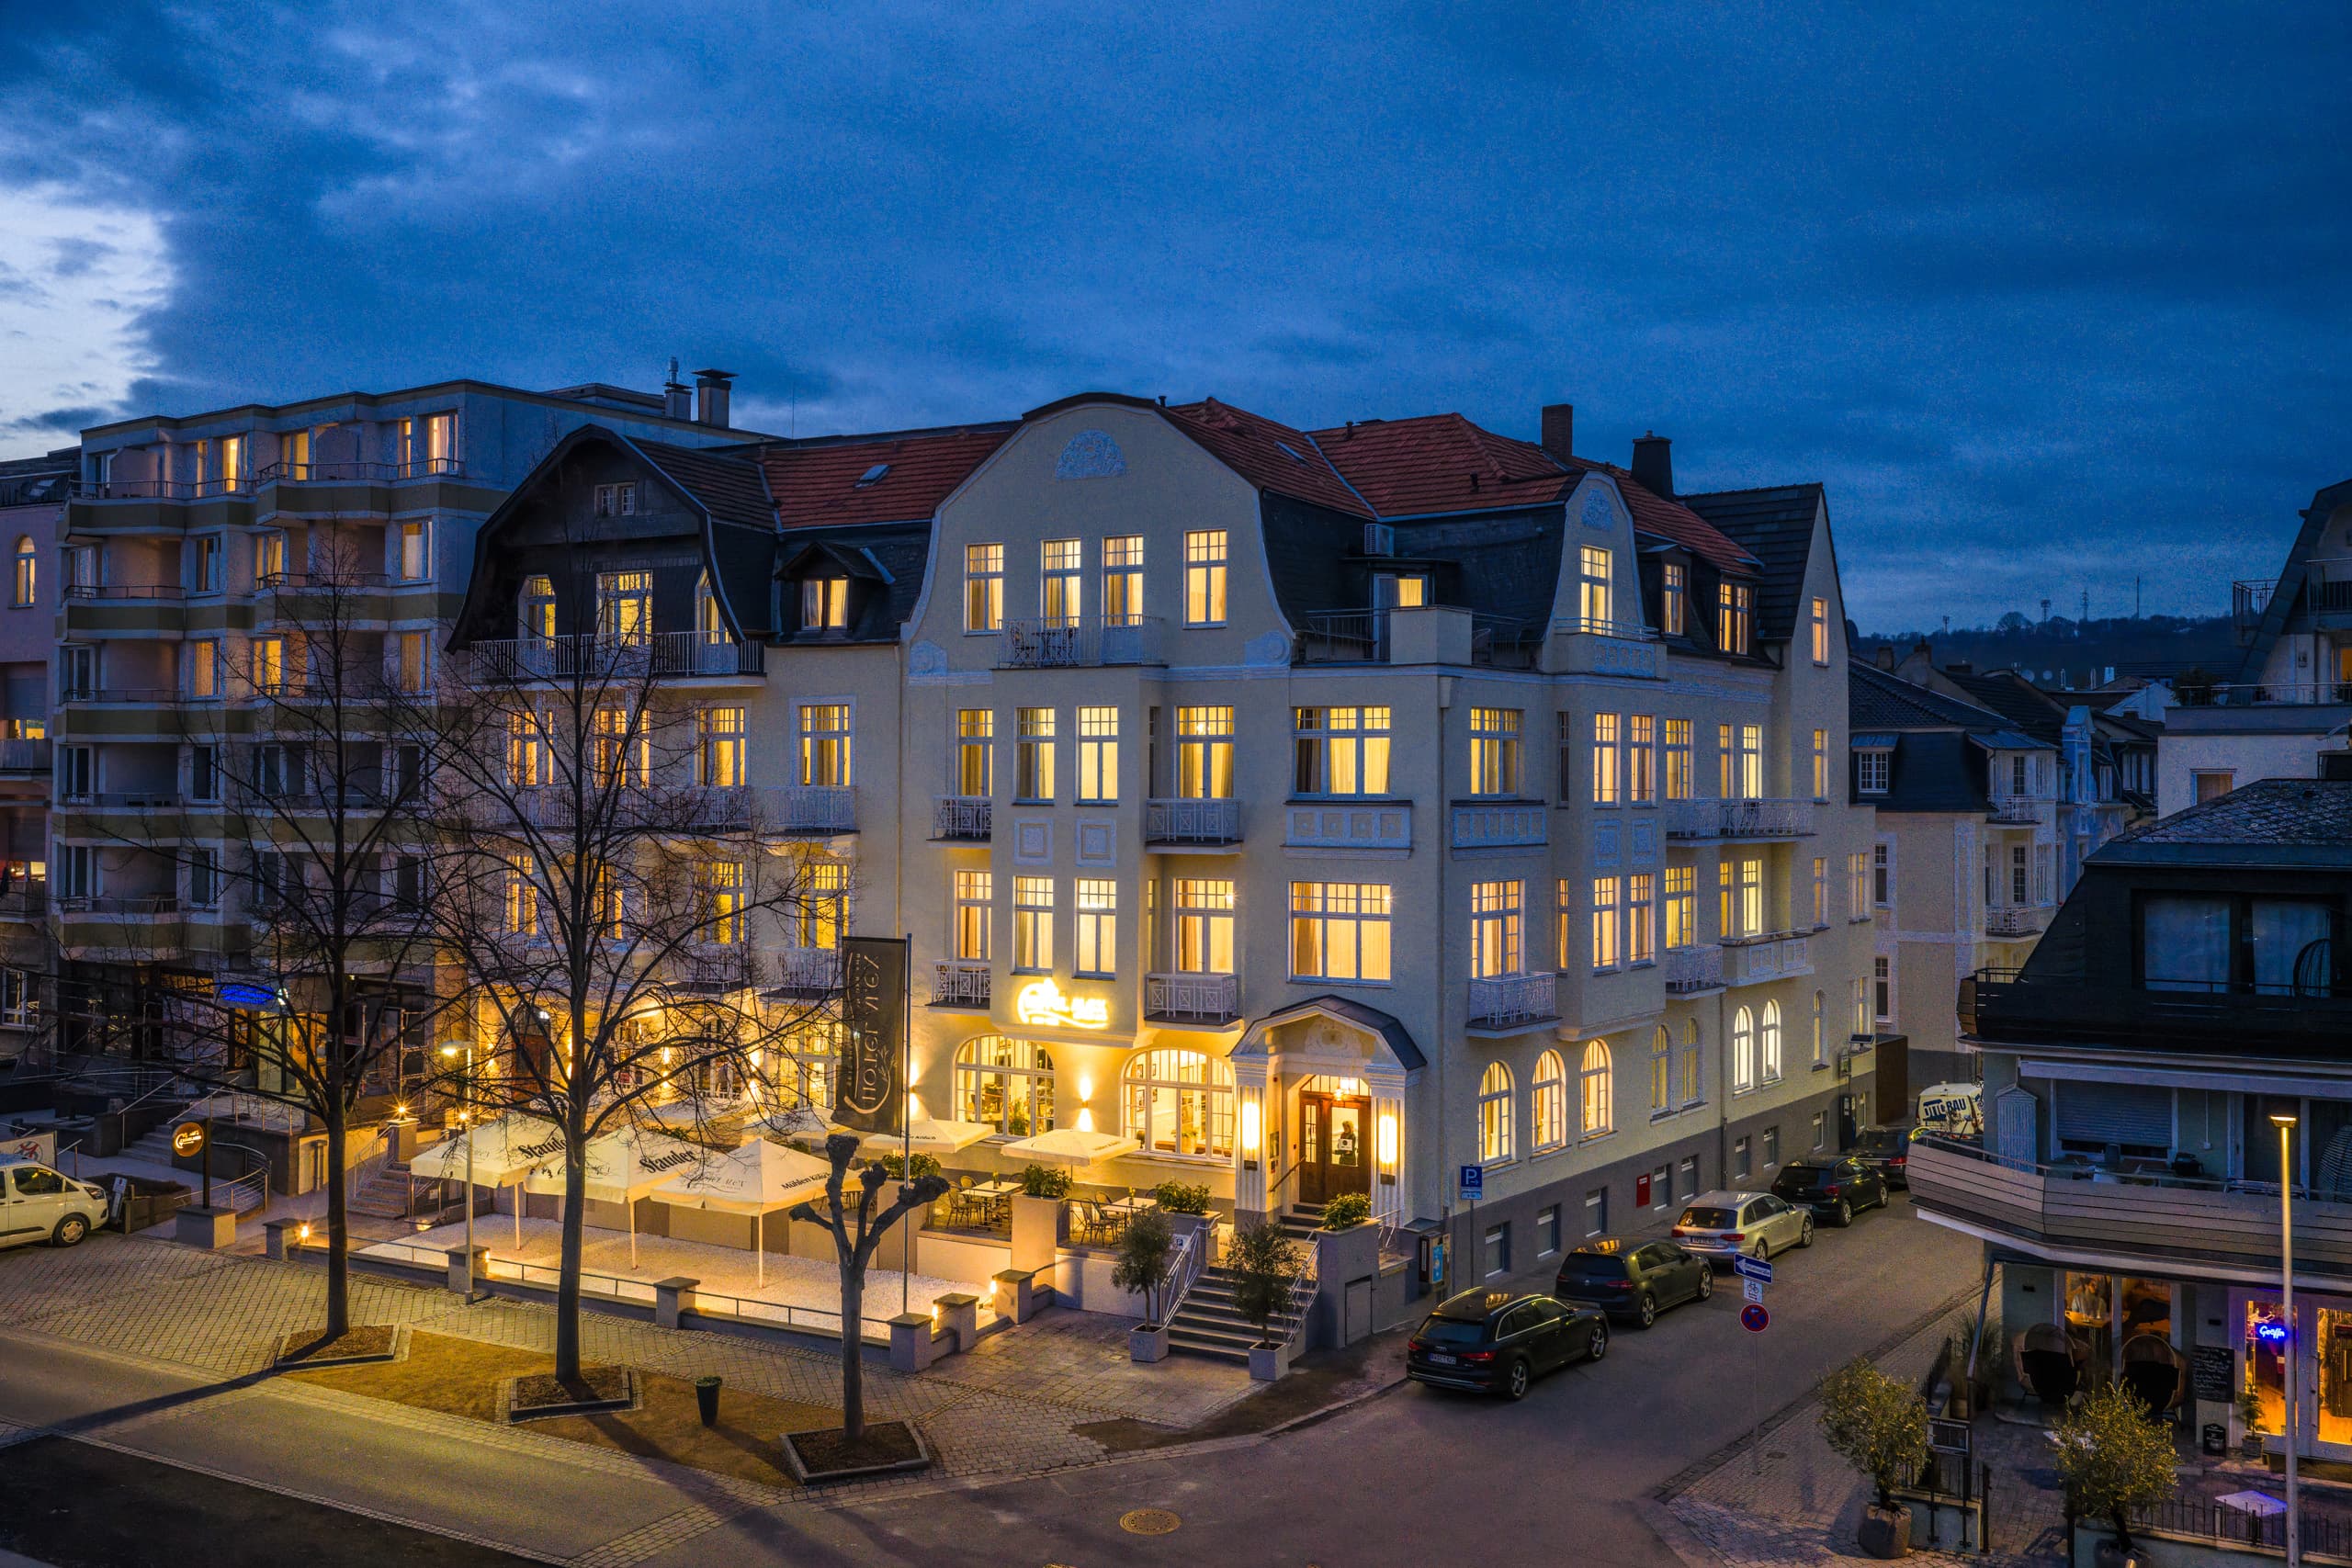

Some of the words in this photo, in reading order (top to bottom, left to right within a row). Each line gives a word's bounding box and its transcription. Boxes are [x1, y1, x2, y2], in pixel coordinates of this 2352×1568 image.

[1946, 1098, 1966, 1113] BAU
[518, 1136, 567, 1159] Staude
[639, 1149, 697, 1174] Stauder
[1465, 1168, 1477, 1185] P
